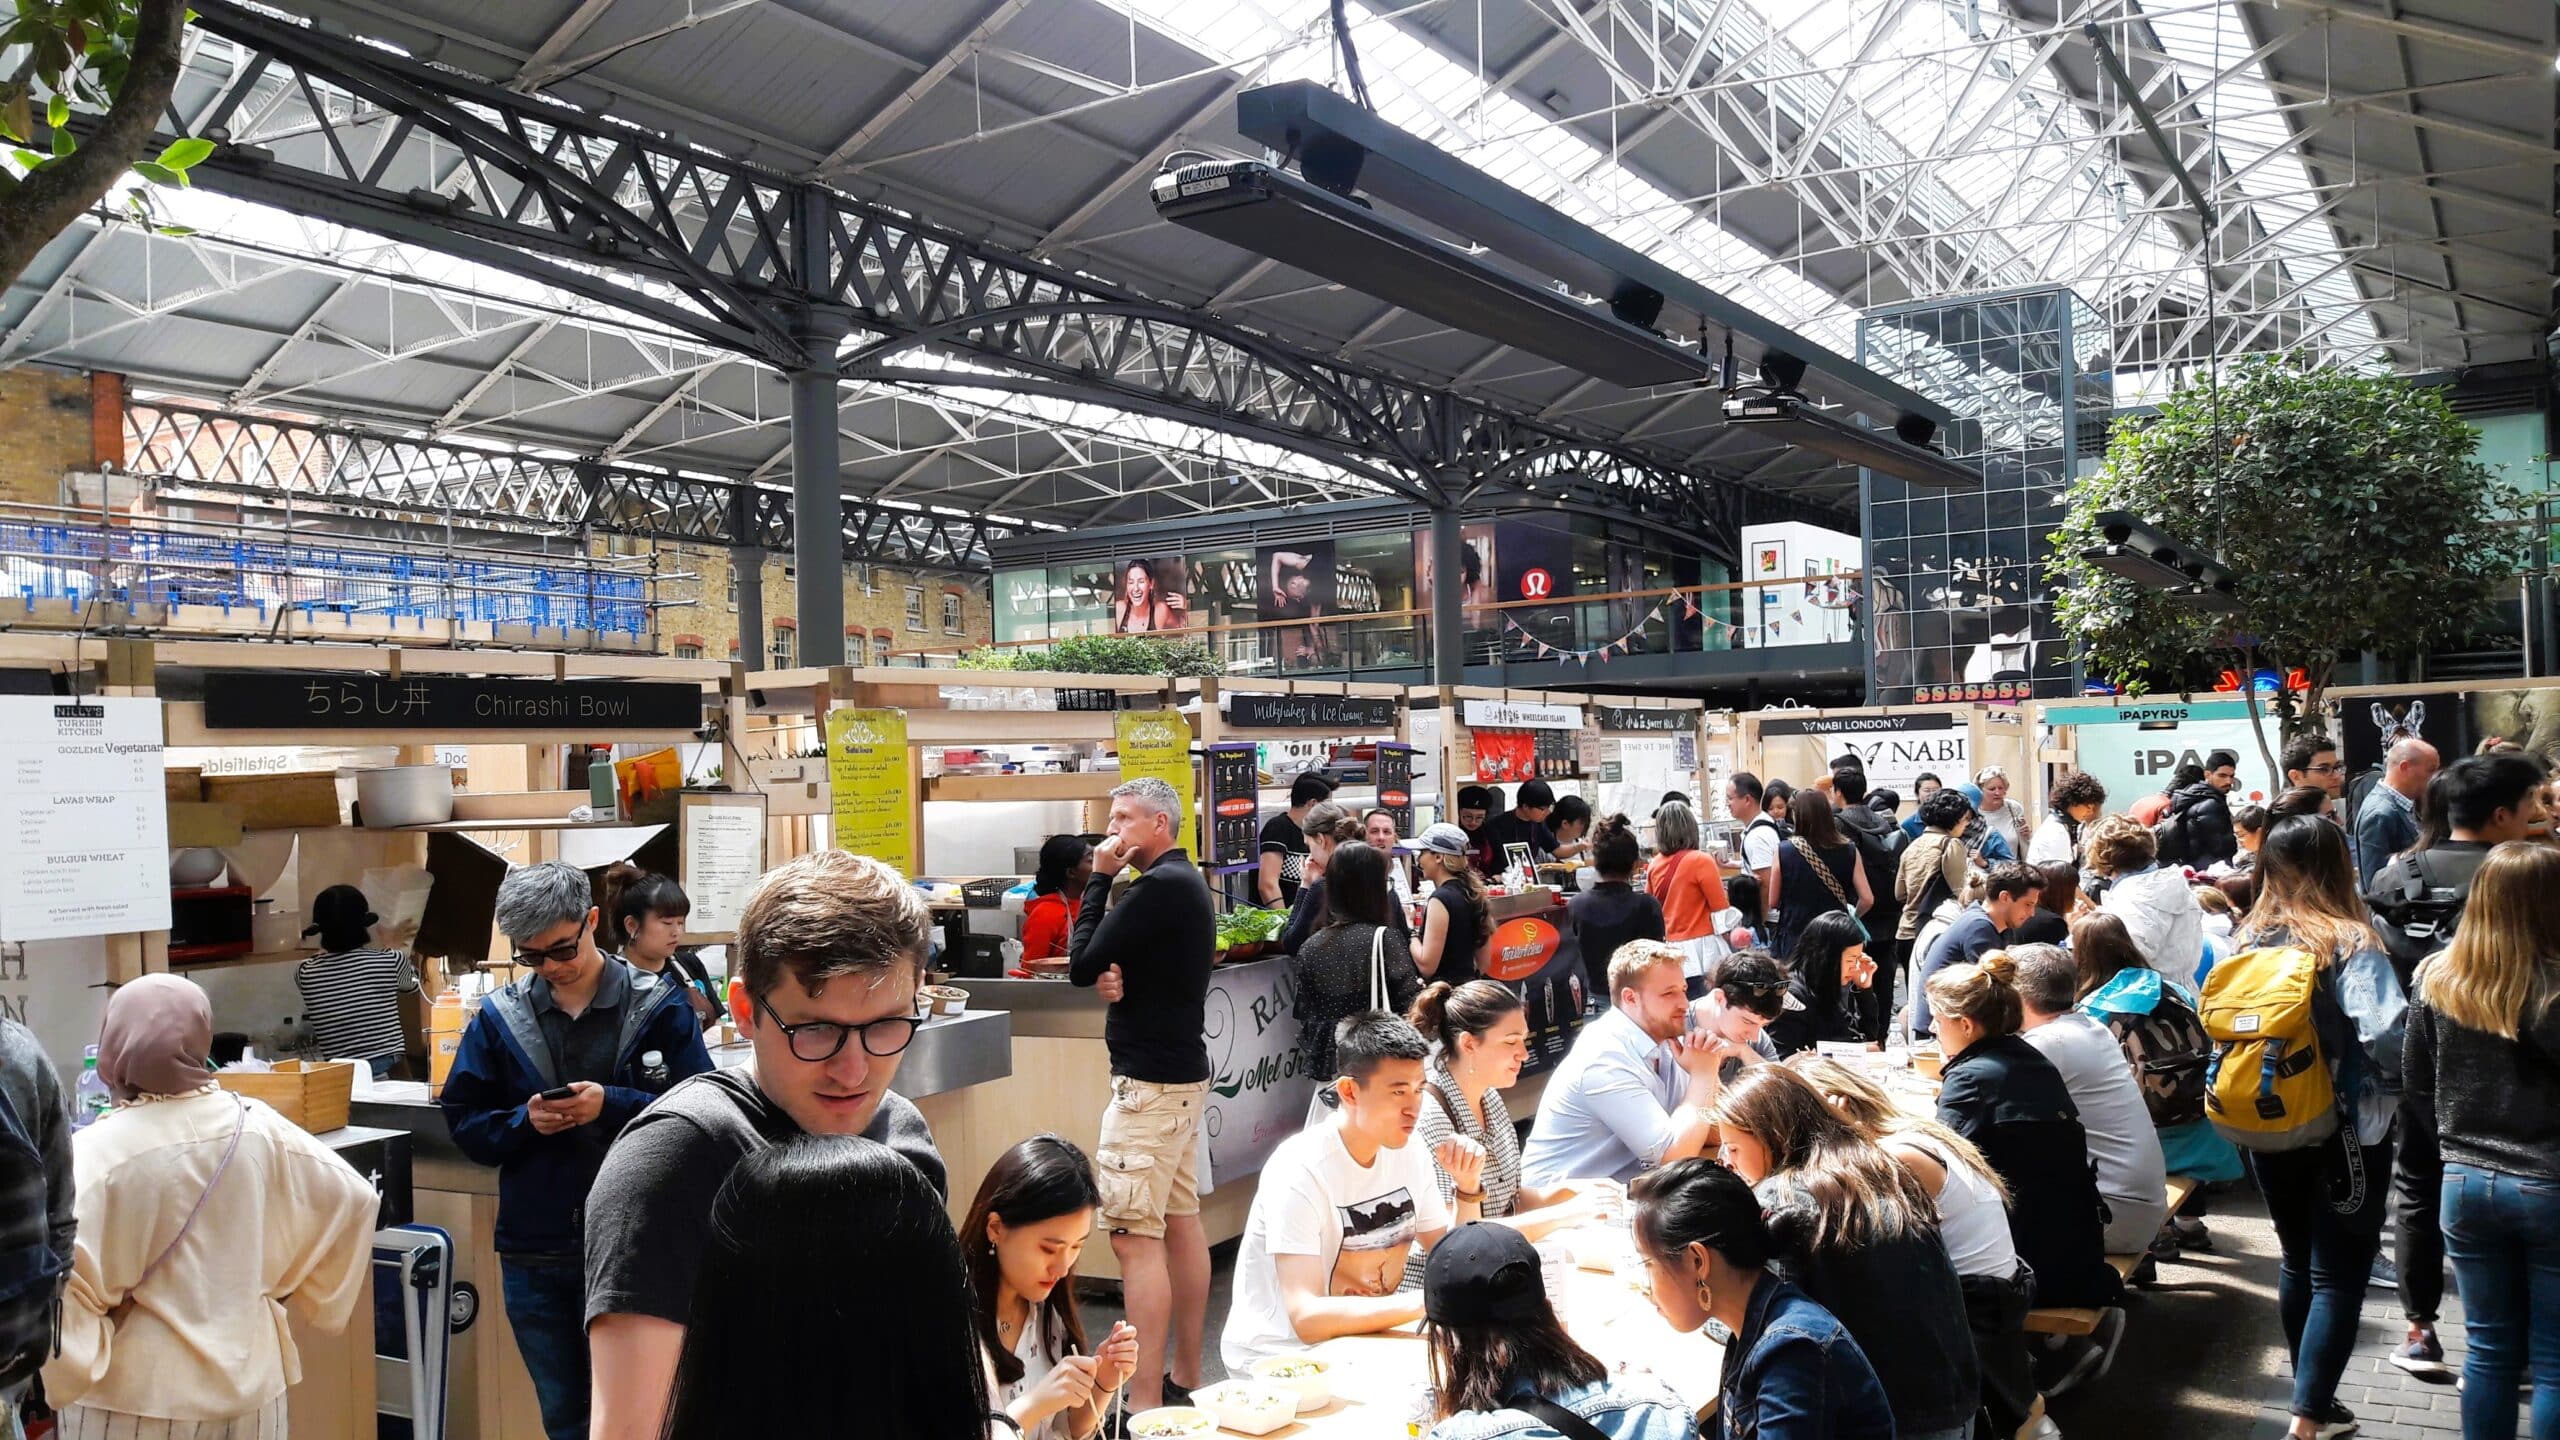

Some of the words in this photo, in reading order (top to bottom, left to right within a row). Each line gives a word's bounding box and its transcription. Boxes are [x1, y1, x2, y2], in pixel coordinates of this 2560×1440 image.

[303, 681, 431, 716] ちらし丼
[474, 694, 568, 716] Chirashi
[580, 696, 630, 716] Bowl
[1254, 703, 1306, 725] Milkshakes
[1323, 703, 1337, 721] Ice
[58, 719, 102, 728] TURKISH
[1817, 721, 1842, 731] NABI
[1845, 719, 1891, 730] LONDON
[58, 728, 102, 736] KITCHEN
[58, 746, 104, 754] GOZLEME
[105, 743, 164, 755] Vegetarian
[1891, 738, 1965, 763] NABI
[85, 796, 116, 804] WRAP
[47, 854, 87, 864] BULGUR
[89, 853, 125, 862] WHEAT
[1246, 1053, 1282, 1093] Mel
